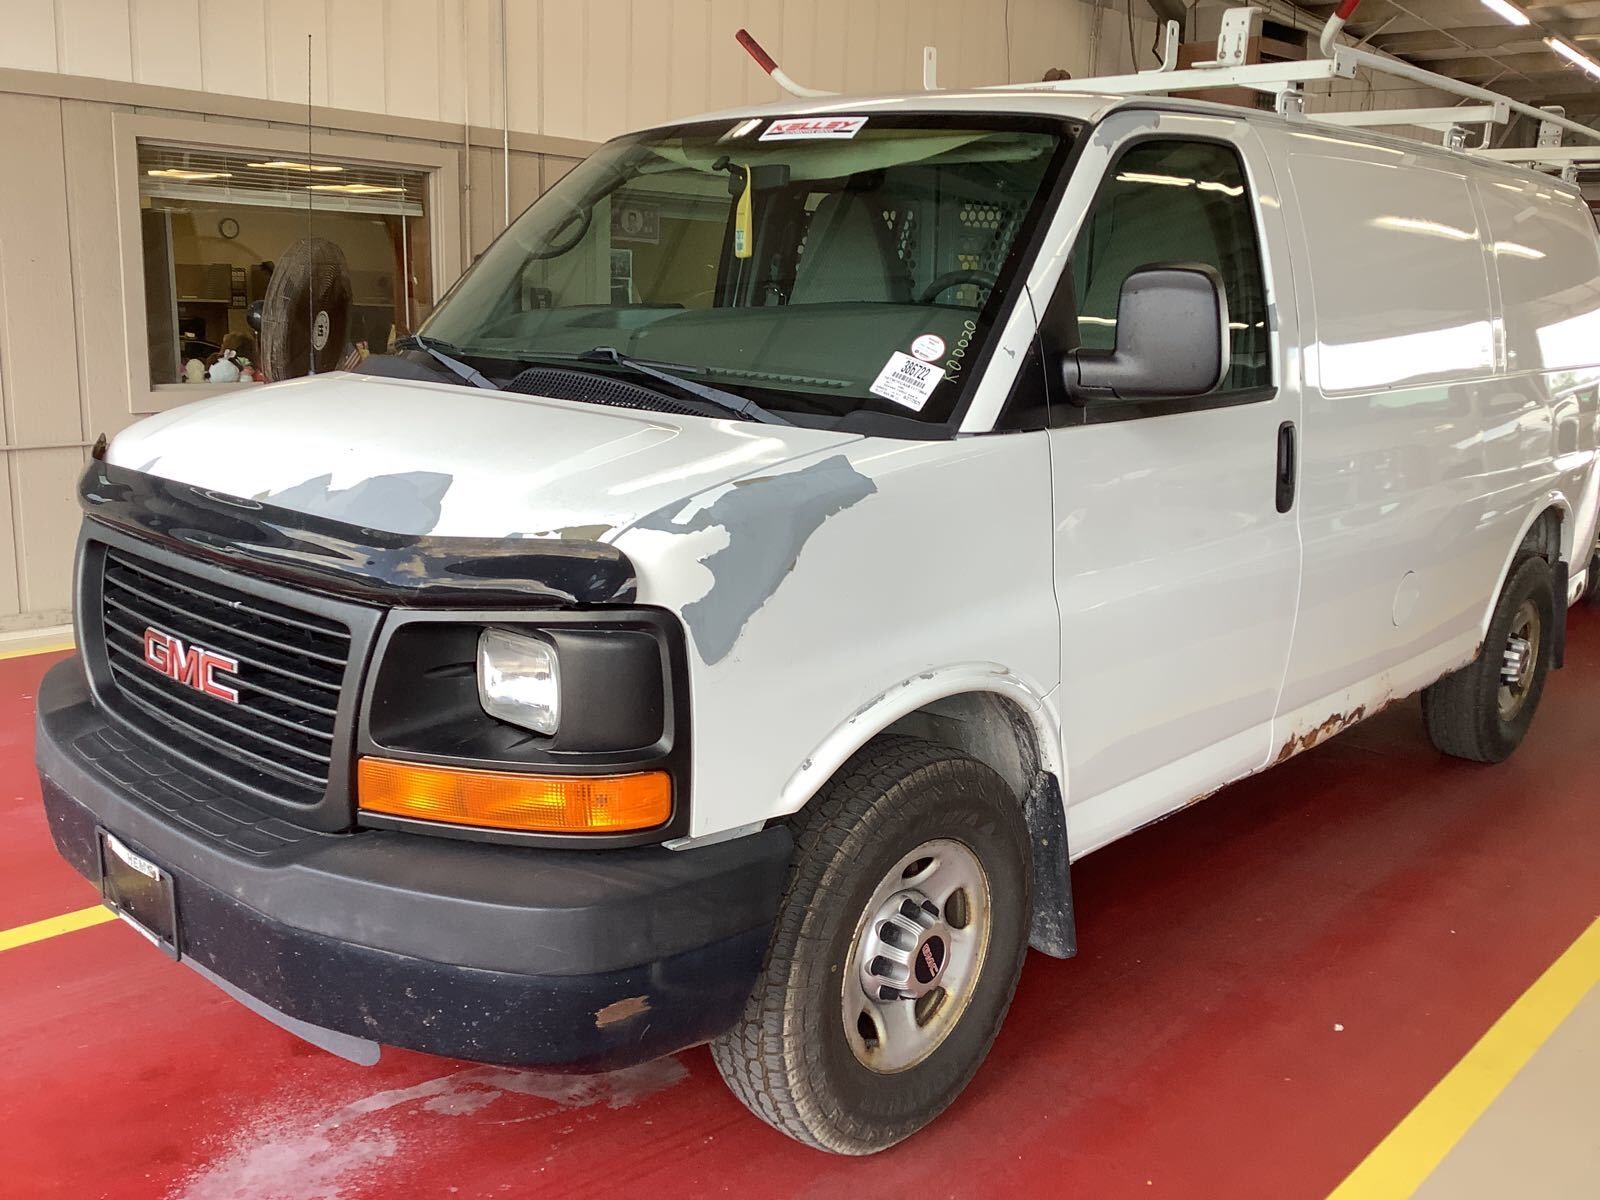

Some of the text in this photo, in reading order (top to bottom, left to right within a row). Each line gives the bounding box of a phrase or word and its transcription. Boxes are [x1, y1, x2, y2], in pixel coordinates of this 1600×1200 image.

[772, 121, 859, 132] KELLEY
[900, 360, 931, 381] 386722
[144, 626, 239, 704] GMC
[922, 943, 939, 977] GMC
